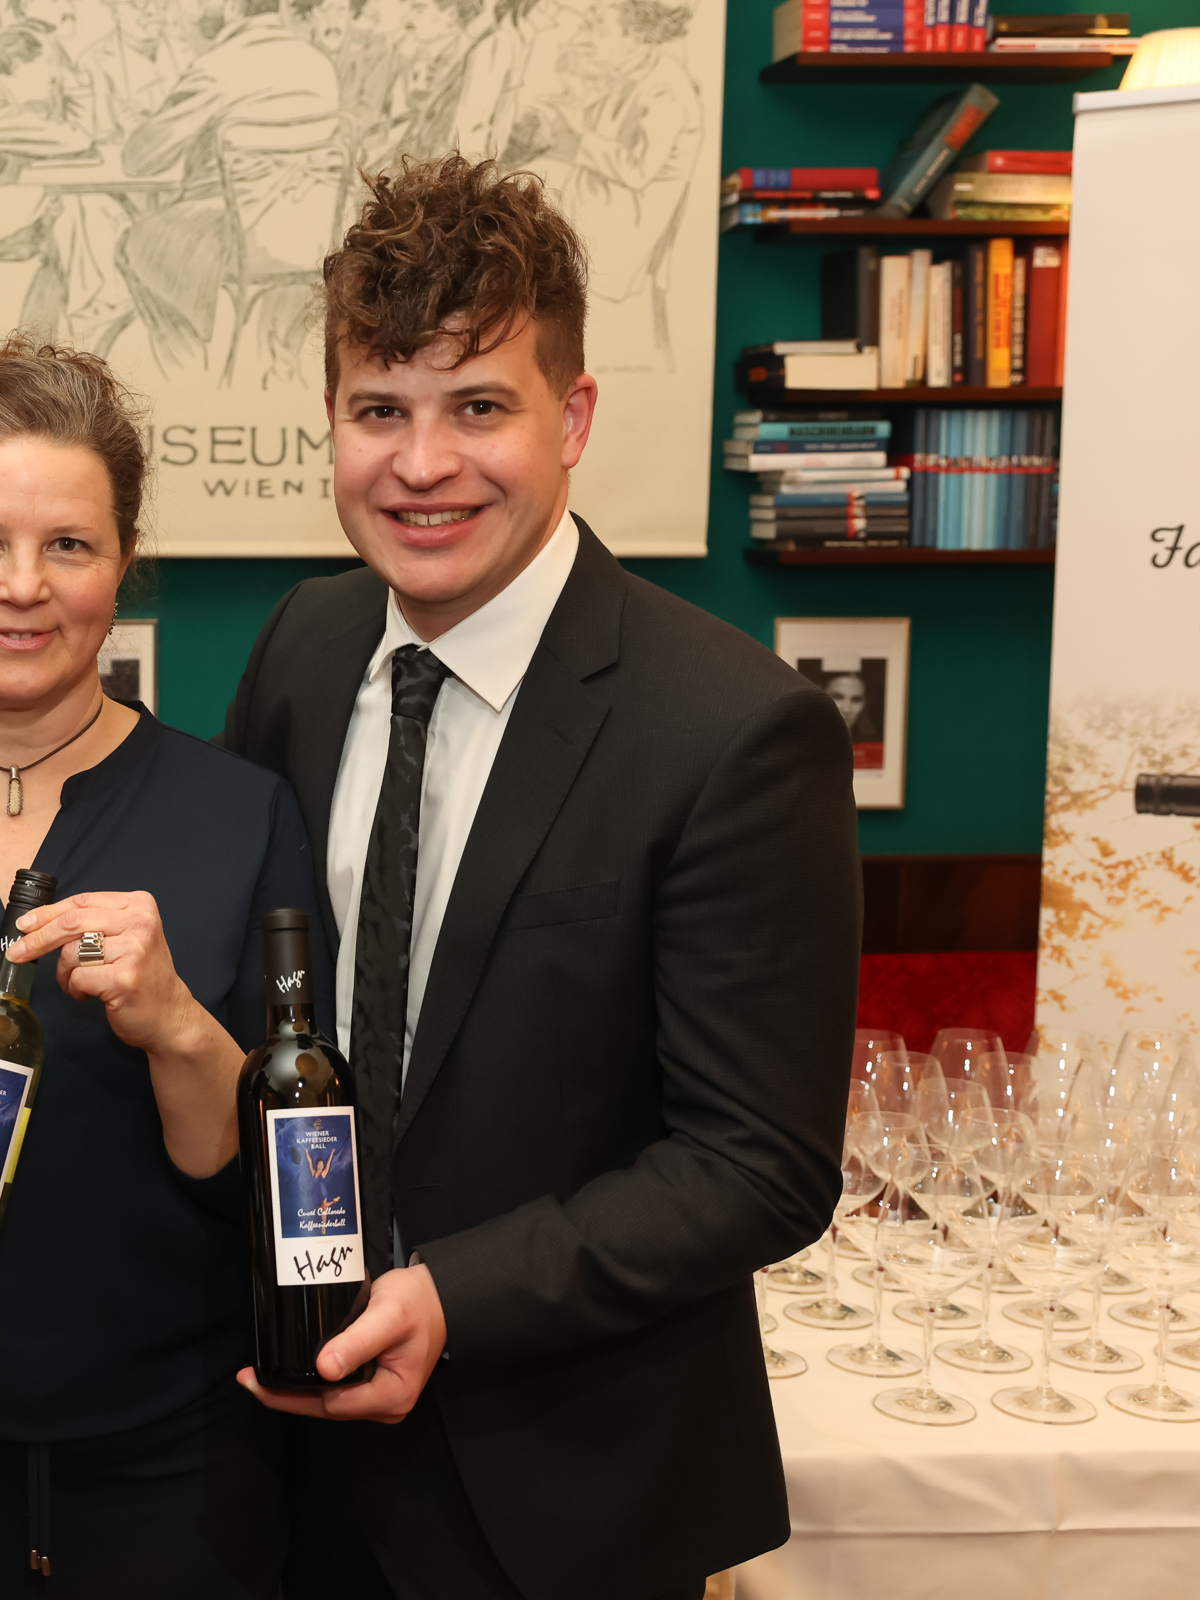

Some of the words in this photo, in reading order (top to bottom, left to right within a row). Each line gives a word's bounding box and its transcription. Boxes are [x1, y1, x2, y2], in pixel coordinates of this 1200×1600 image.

[203, 478, 303, 498] WIEN
[296, 1136, 338, 1144] KAFFEESIEDER
[293, 1246, 353, 1281] Hagn
